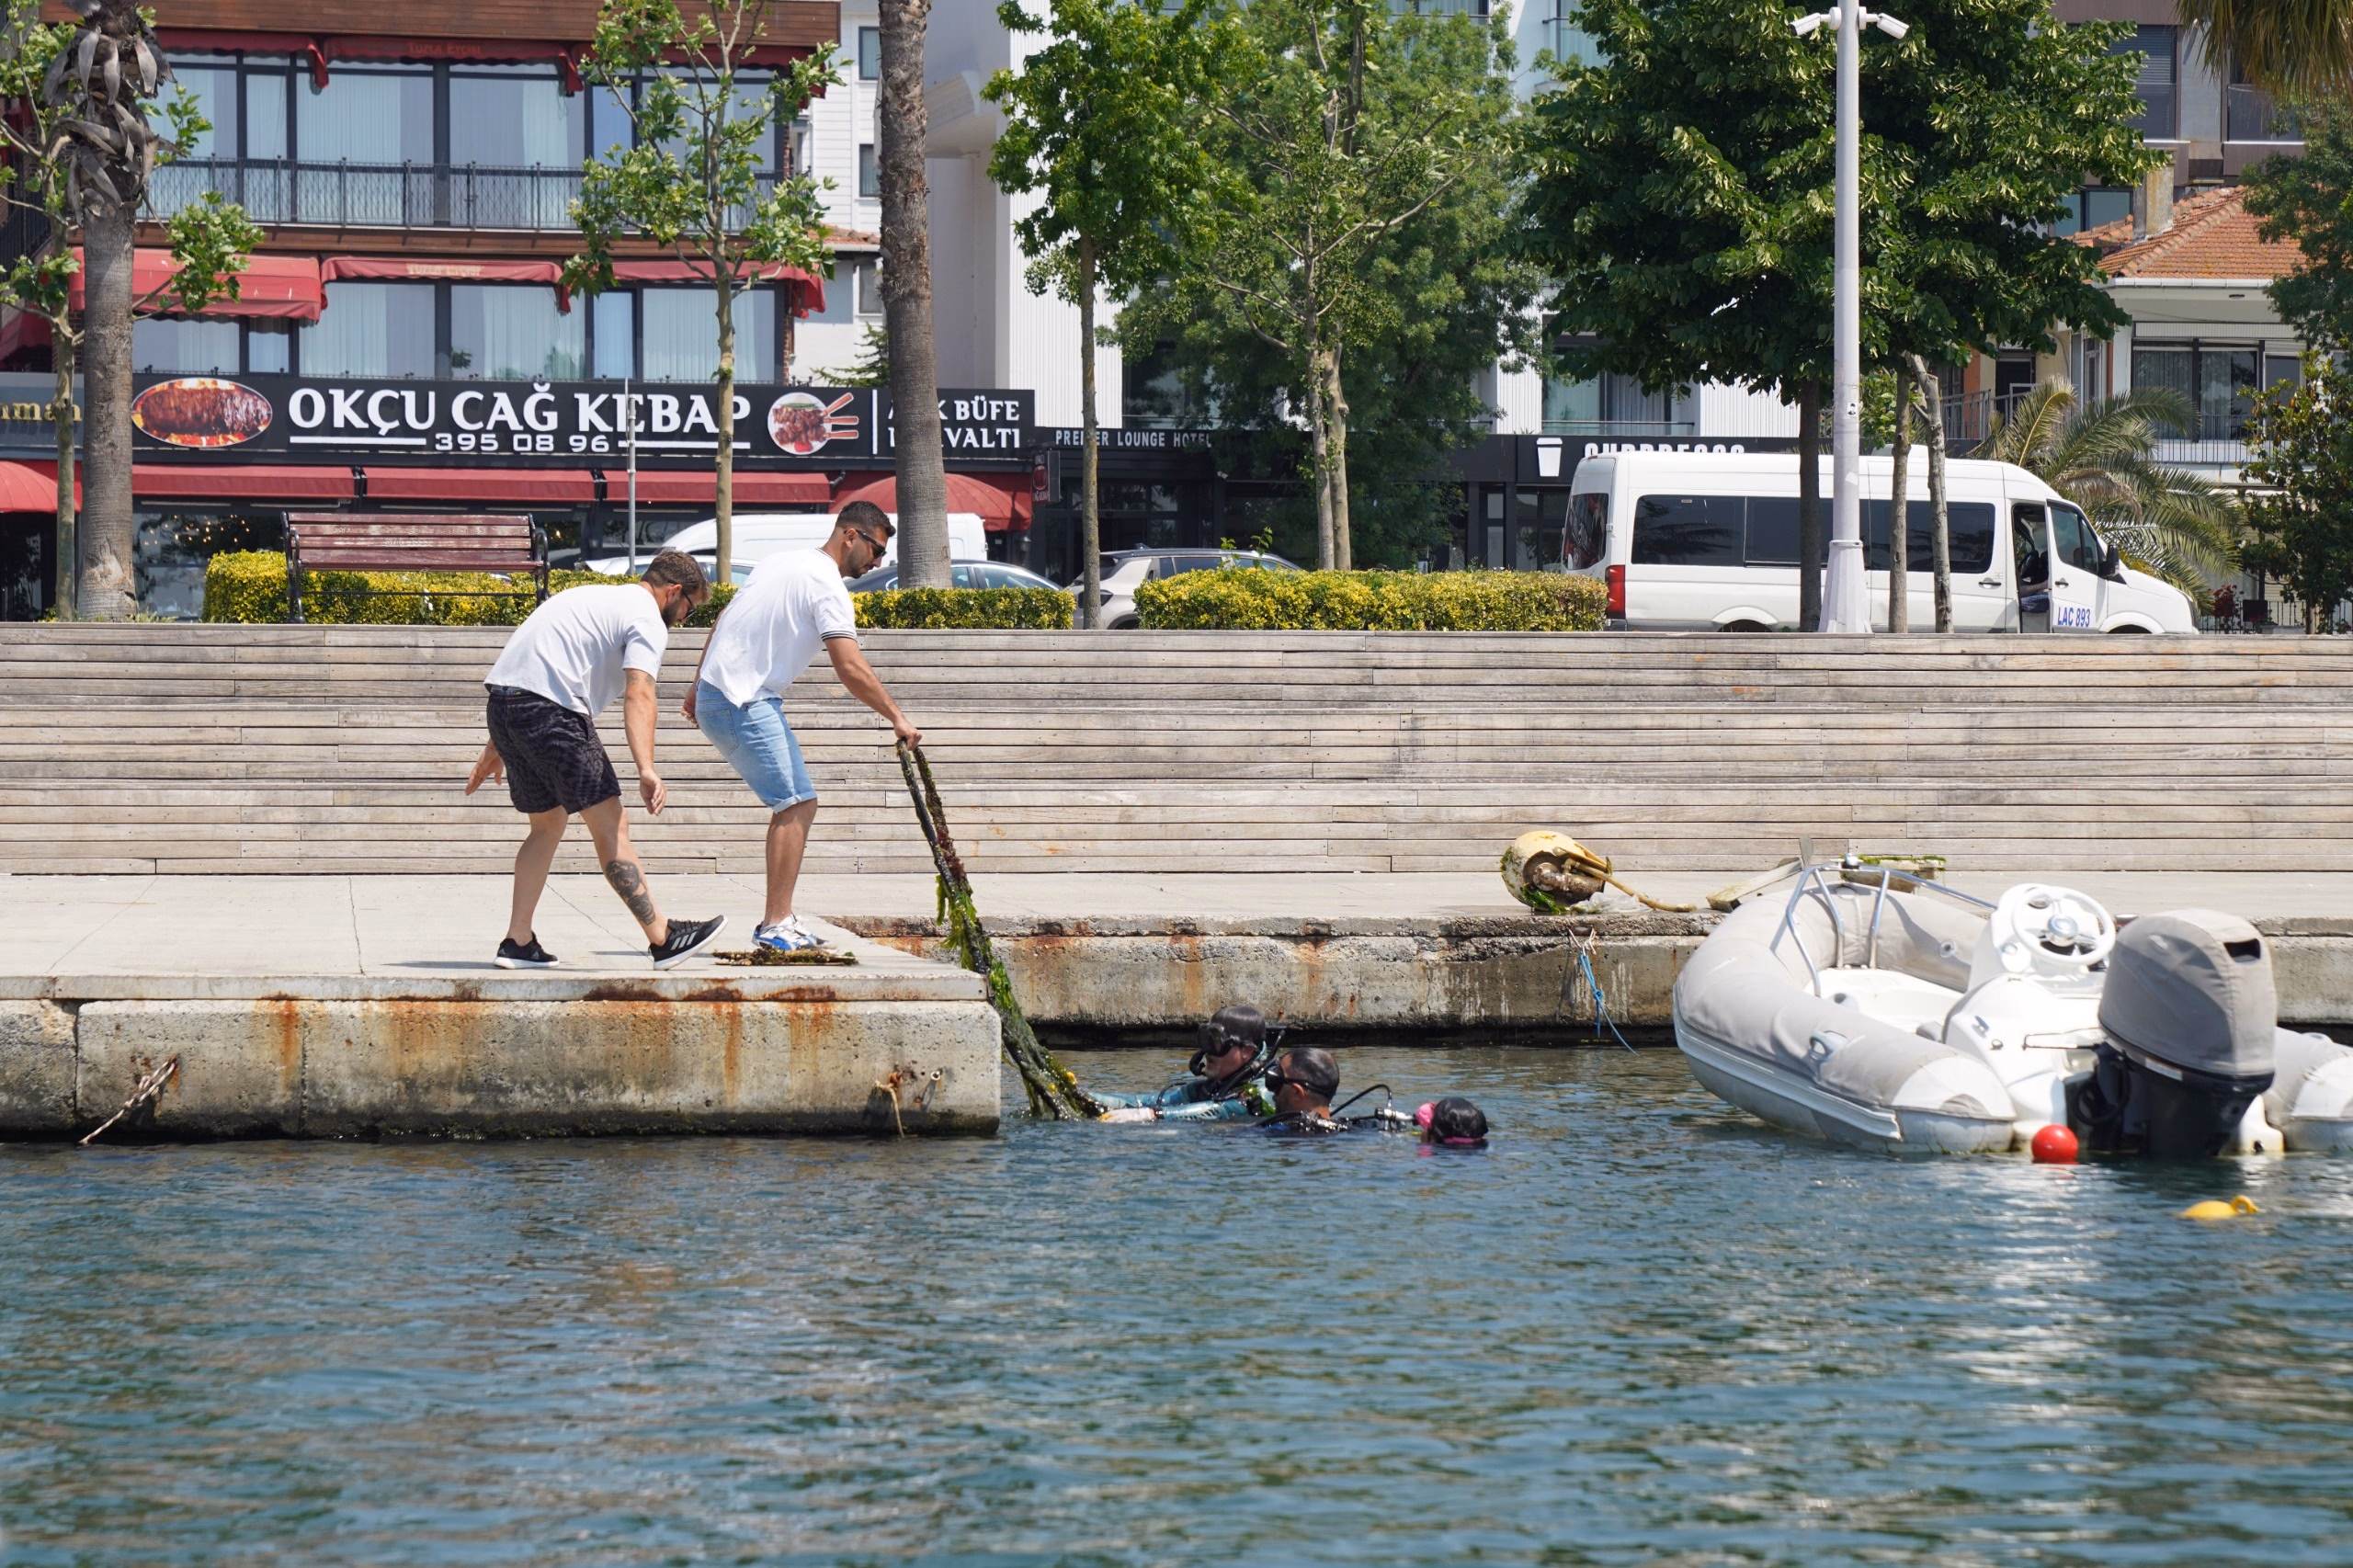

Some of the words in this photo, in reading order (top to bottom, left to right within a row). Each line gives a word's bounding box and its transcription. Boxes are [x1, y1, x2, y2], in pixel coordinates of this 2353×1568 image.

[289, 388, 435, 437] OKÇU
[451, 382, 558, 431] CAĞ
[954, 395, 1019, 420] BÜFE
[435, 433, 498, 450] 395
[513, 434, 553, 451] 08
[569, 435, 609, 452] 96
[888, 427, 1019, 448] VALTI
[1056, 430, 1108, 446] PREER
[1118, 432, 1165, 447] LOUNGE
[2058, 607, 2074, 626] LAC
[2075, 608, 2091, 627] 893
